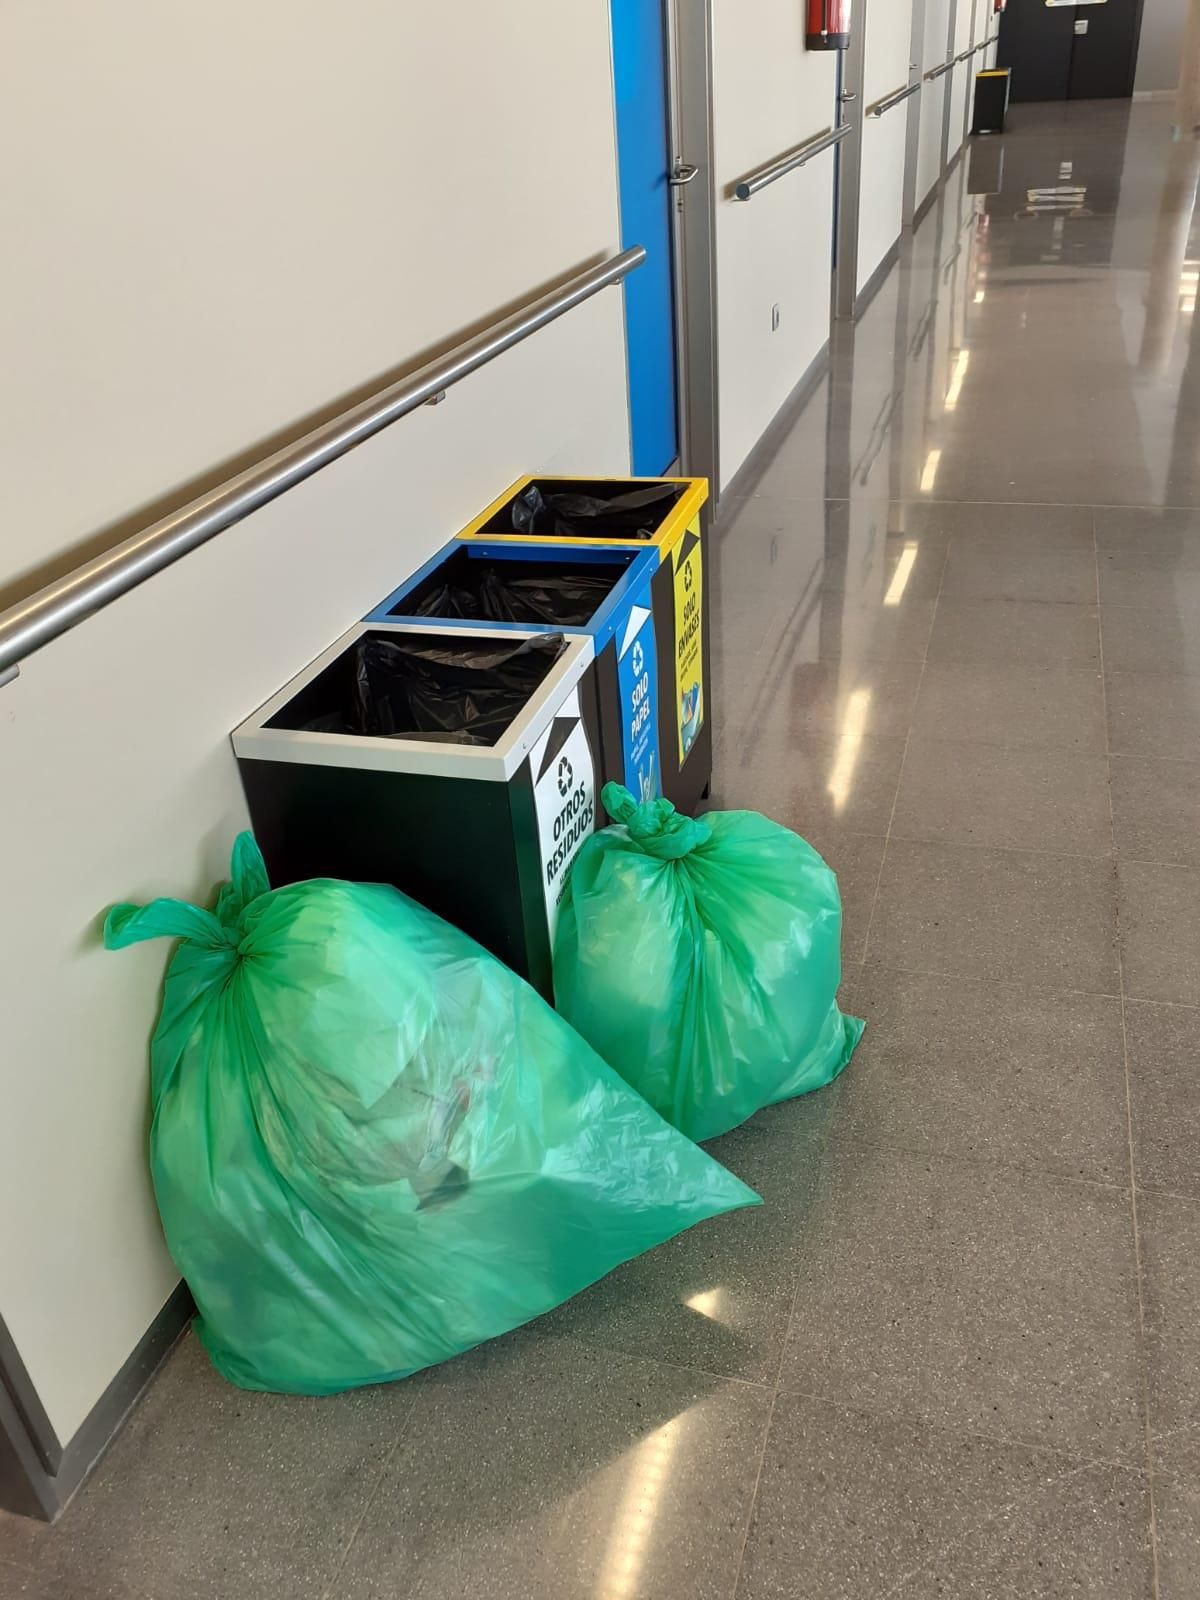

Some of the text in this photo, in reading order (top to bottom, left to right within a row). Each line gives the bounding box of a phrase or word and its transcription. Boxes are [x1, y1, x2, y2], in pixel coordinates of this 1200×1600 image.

[683, 592, 696, 626] SOLO
[678, 609, 700, 660] ENVASES
[632, 671, 649, 713] SOLO
[631, 696, 650, 742] PAPEL
[553, 780, 585, 841] OTROS
[546, 800, 593, 886] RESIDUOS
